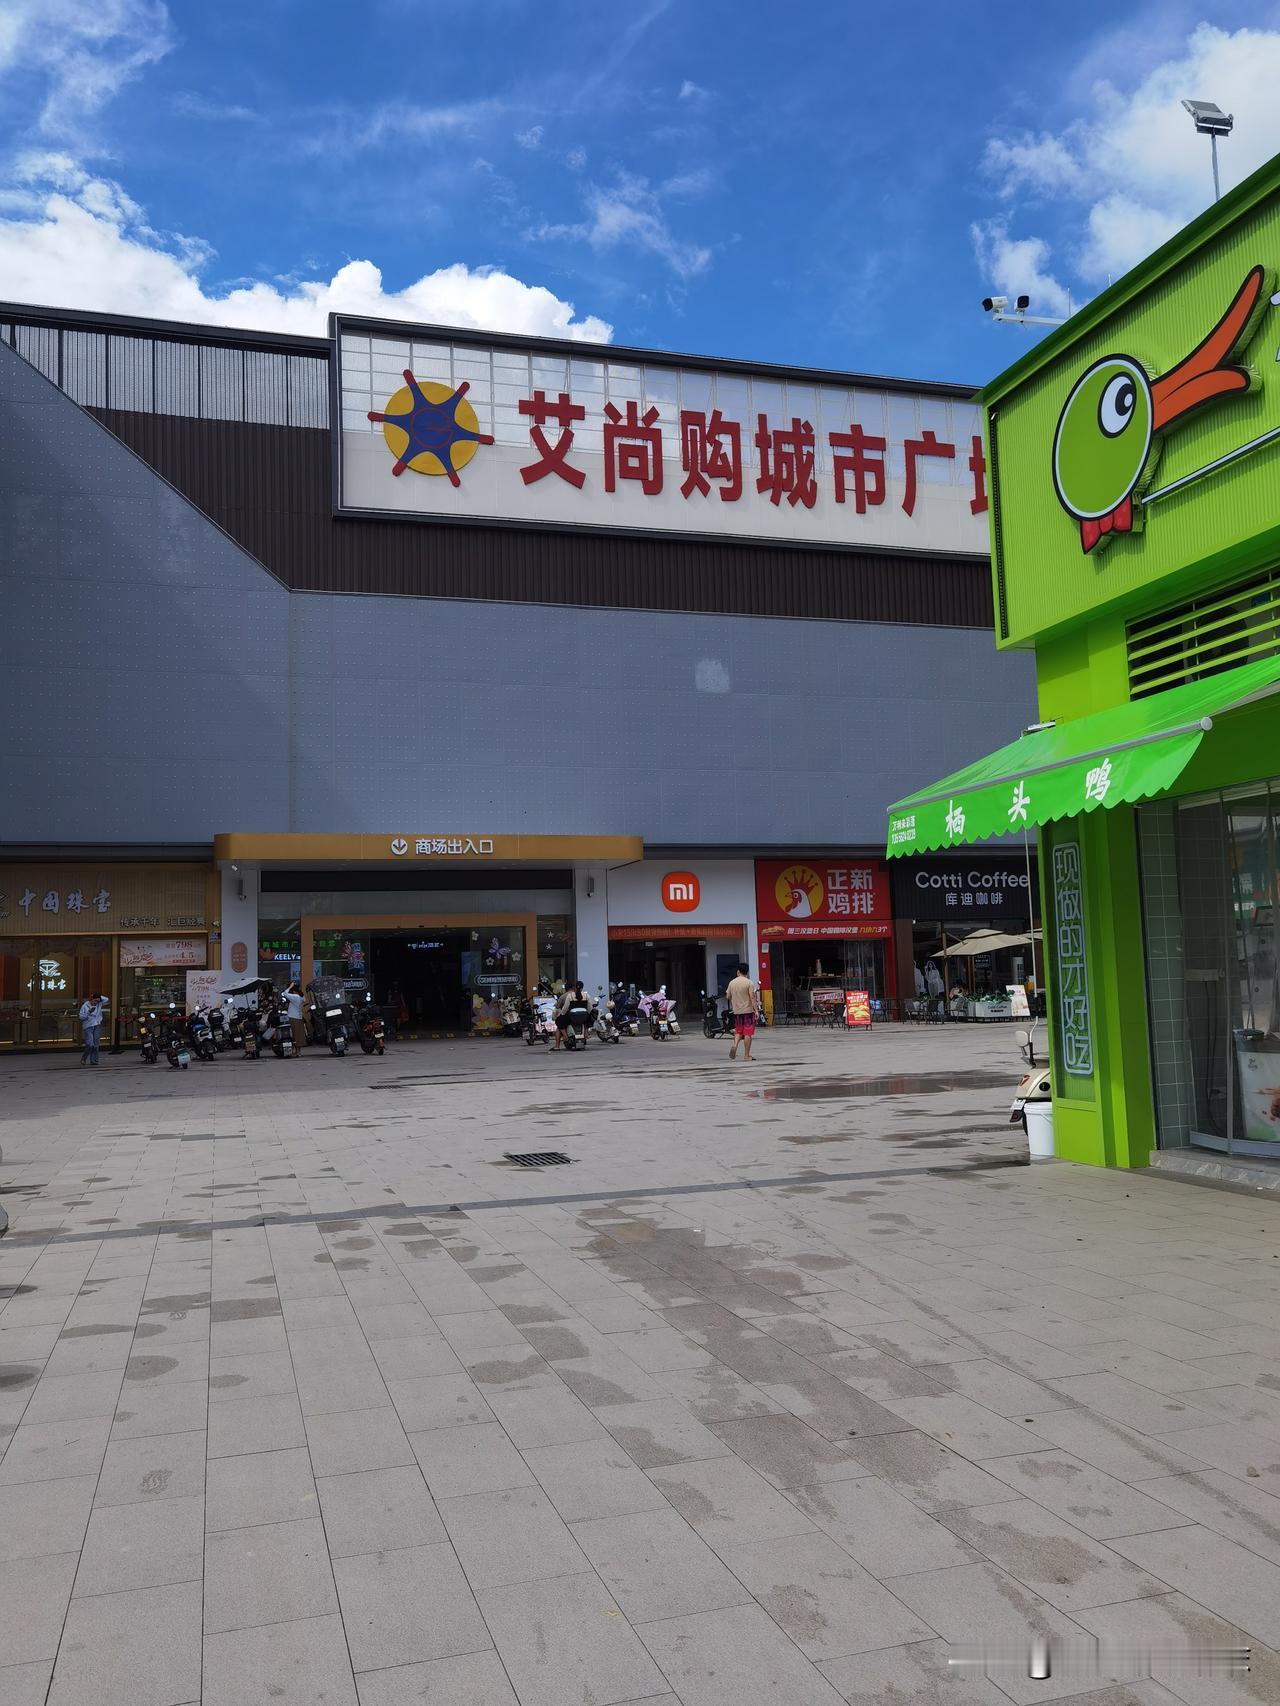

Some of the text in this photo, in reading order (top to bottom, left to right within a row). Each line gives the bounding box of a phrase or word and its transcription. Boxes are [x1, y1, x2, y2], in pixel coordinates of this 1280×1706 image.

[518, 391, 988, 517] 艾尚购城市广
[415, 838, 494, 855] 商场出入口
[827, 869, 873, 890] 正新
[915, 871, 1029, 889] Cotti Coffee
[18, 888, 112, 916] 中国珠宝
[827, 892, 874, 915] 鸡排
[945, 893, 1003, 906] 库迪咖啡
[1055, 849, 1090, 1068] 现做的才好吃
